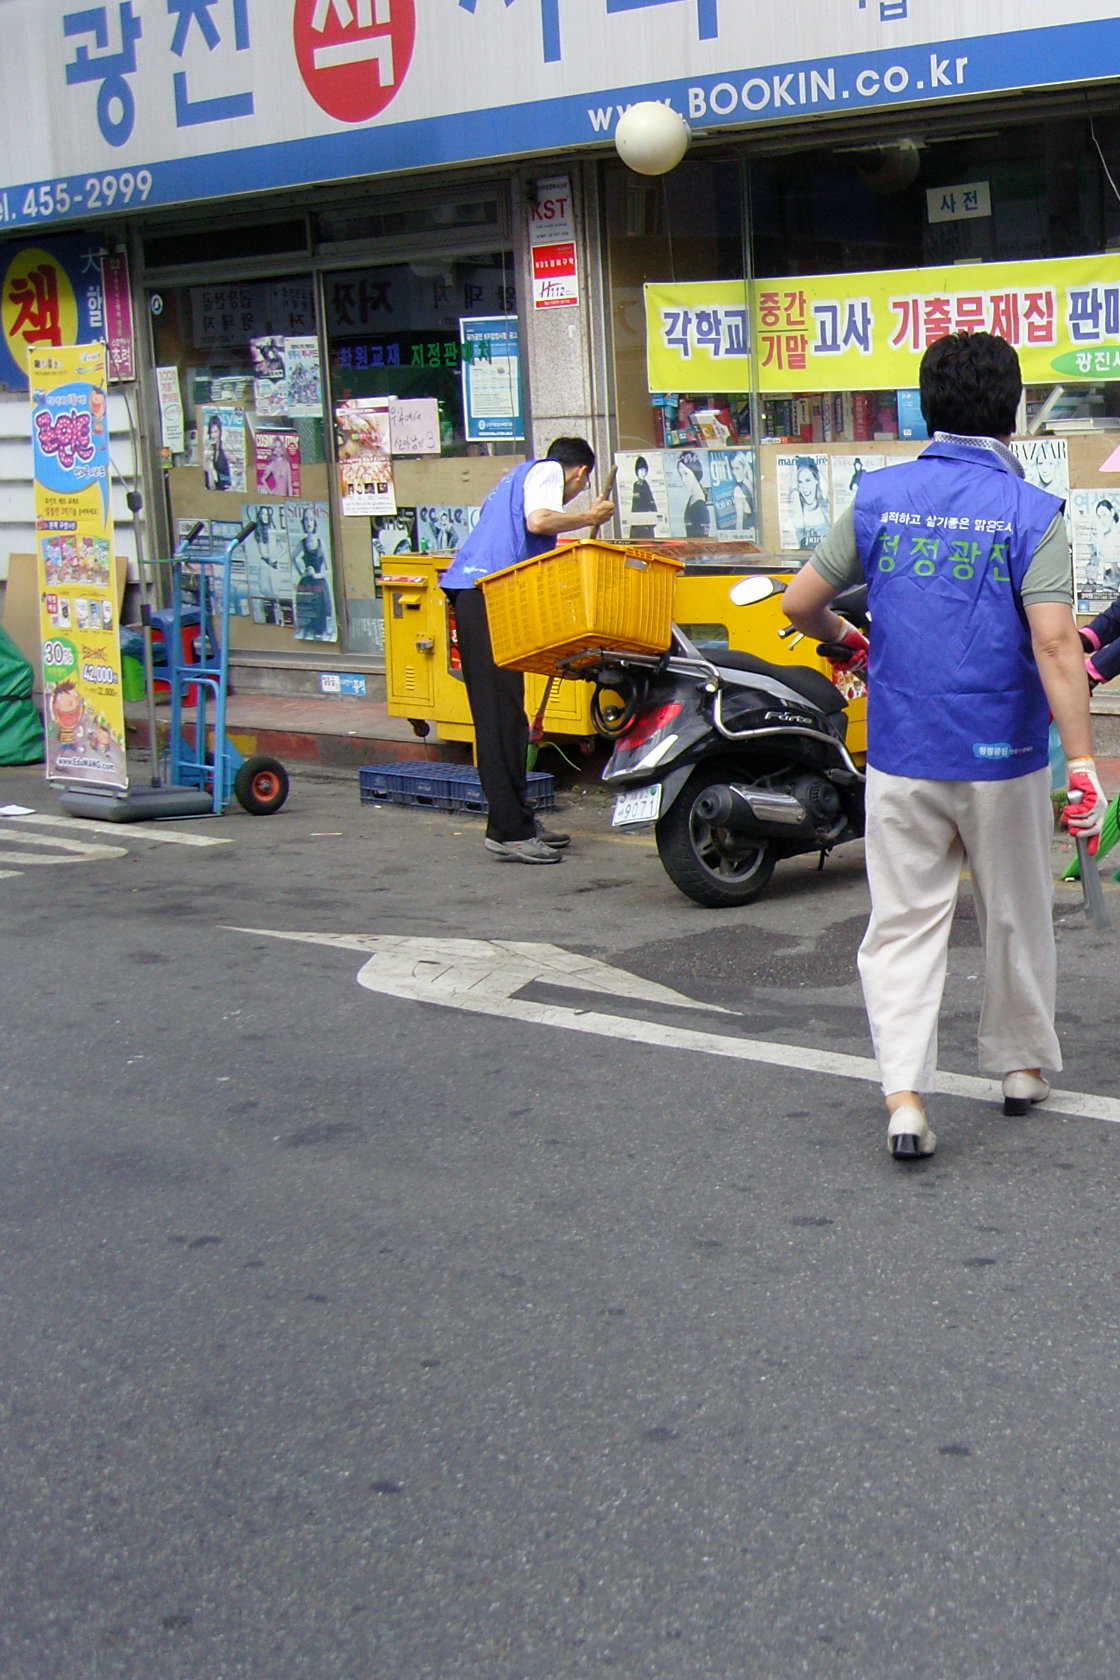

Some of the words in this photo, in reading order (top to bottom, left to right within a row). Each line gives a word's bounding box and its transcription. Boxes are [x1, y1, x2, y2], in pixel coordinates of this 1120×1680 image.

[588, 54, 968, 132] w.BOOKIN.co.kr
[22, 170, 153, 219] 455-2999
[531, 198, 568, 220] KST
[940, 190, 979, 214] 사전
[758, 290, 807, 327] 중간
[814, 301, 872, 352] 고사
[892, 290, 1054, 350] 기출문제집
[663, 308, 749, 356] 각학교
[761, 333, 809, 370] 기말
[1010, 441, 1067, 459] BAZAAR
[925, 515, 970, 530] 살기좋은
[623, 798, 655, 820] 9071
